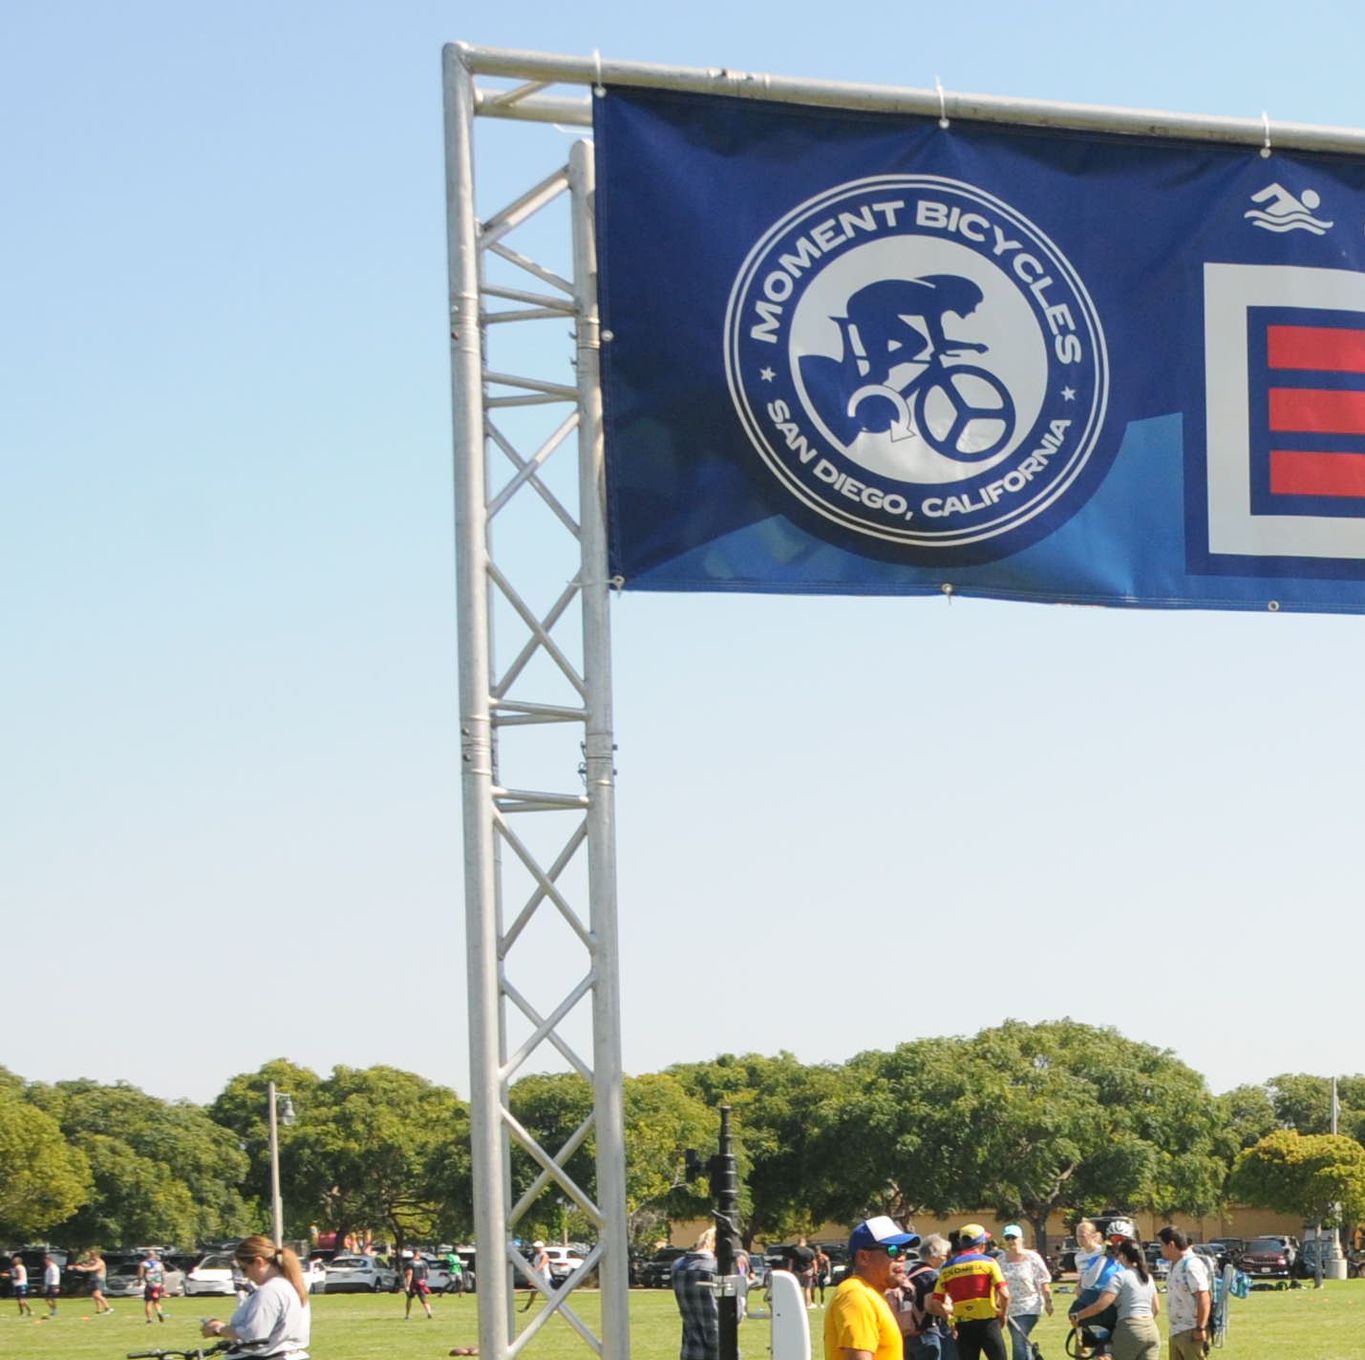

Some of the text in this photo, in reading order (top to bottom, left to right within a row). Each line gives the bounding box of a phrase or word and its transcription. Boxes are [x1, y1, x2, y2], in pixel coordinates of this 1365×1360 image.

[750, 199, 1082, 367] MOMENT BICYCLES
[766, 397, 1073, 521] SAN DIEGO, CALIFORNIA
